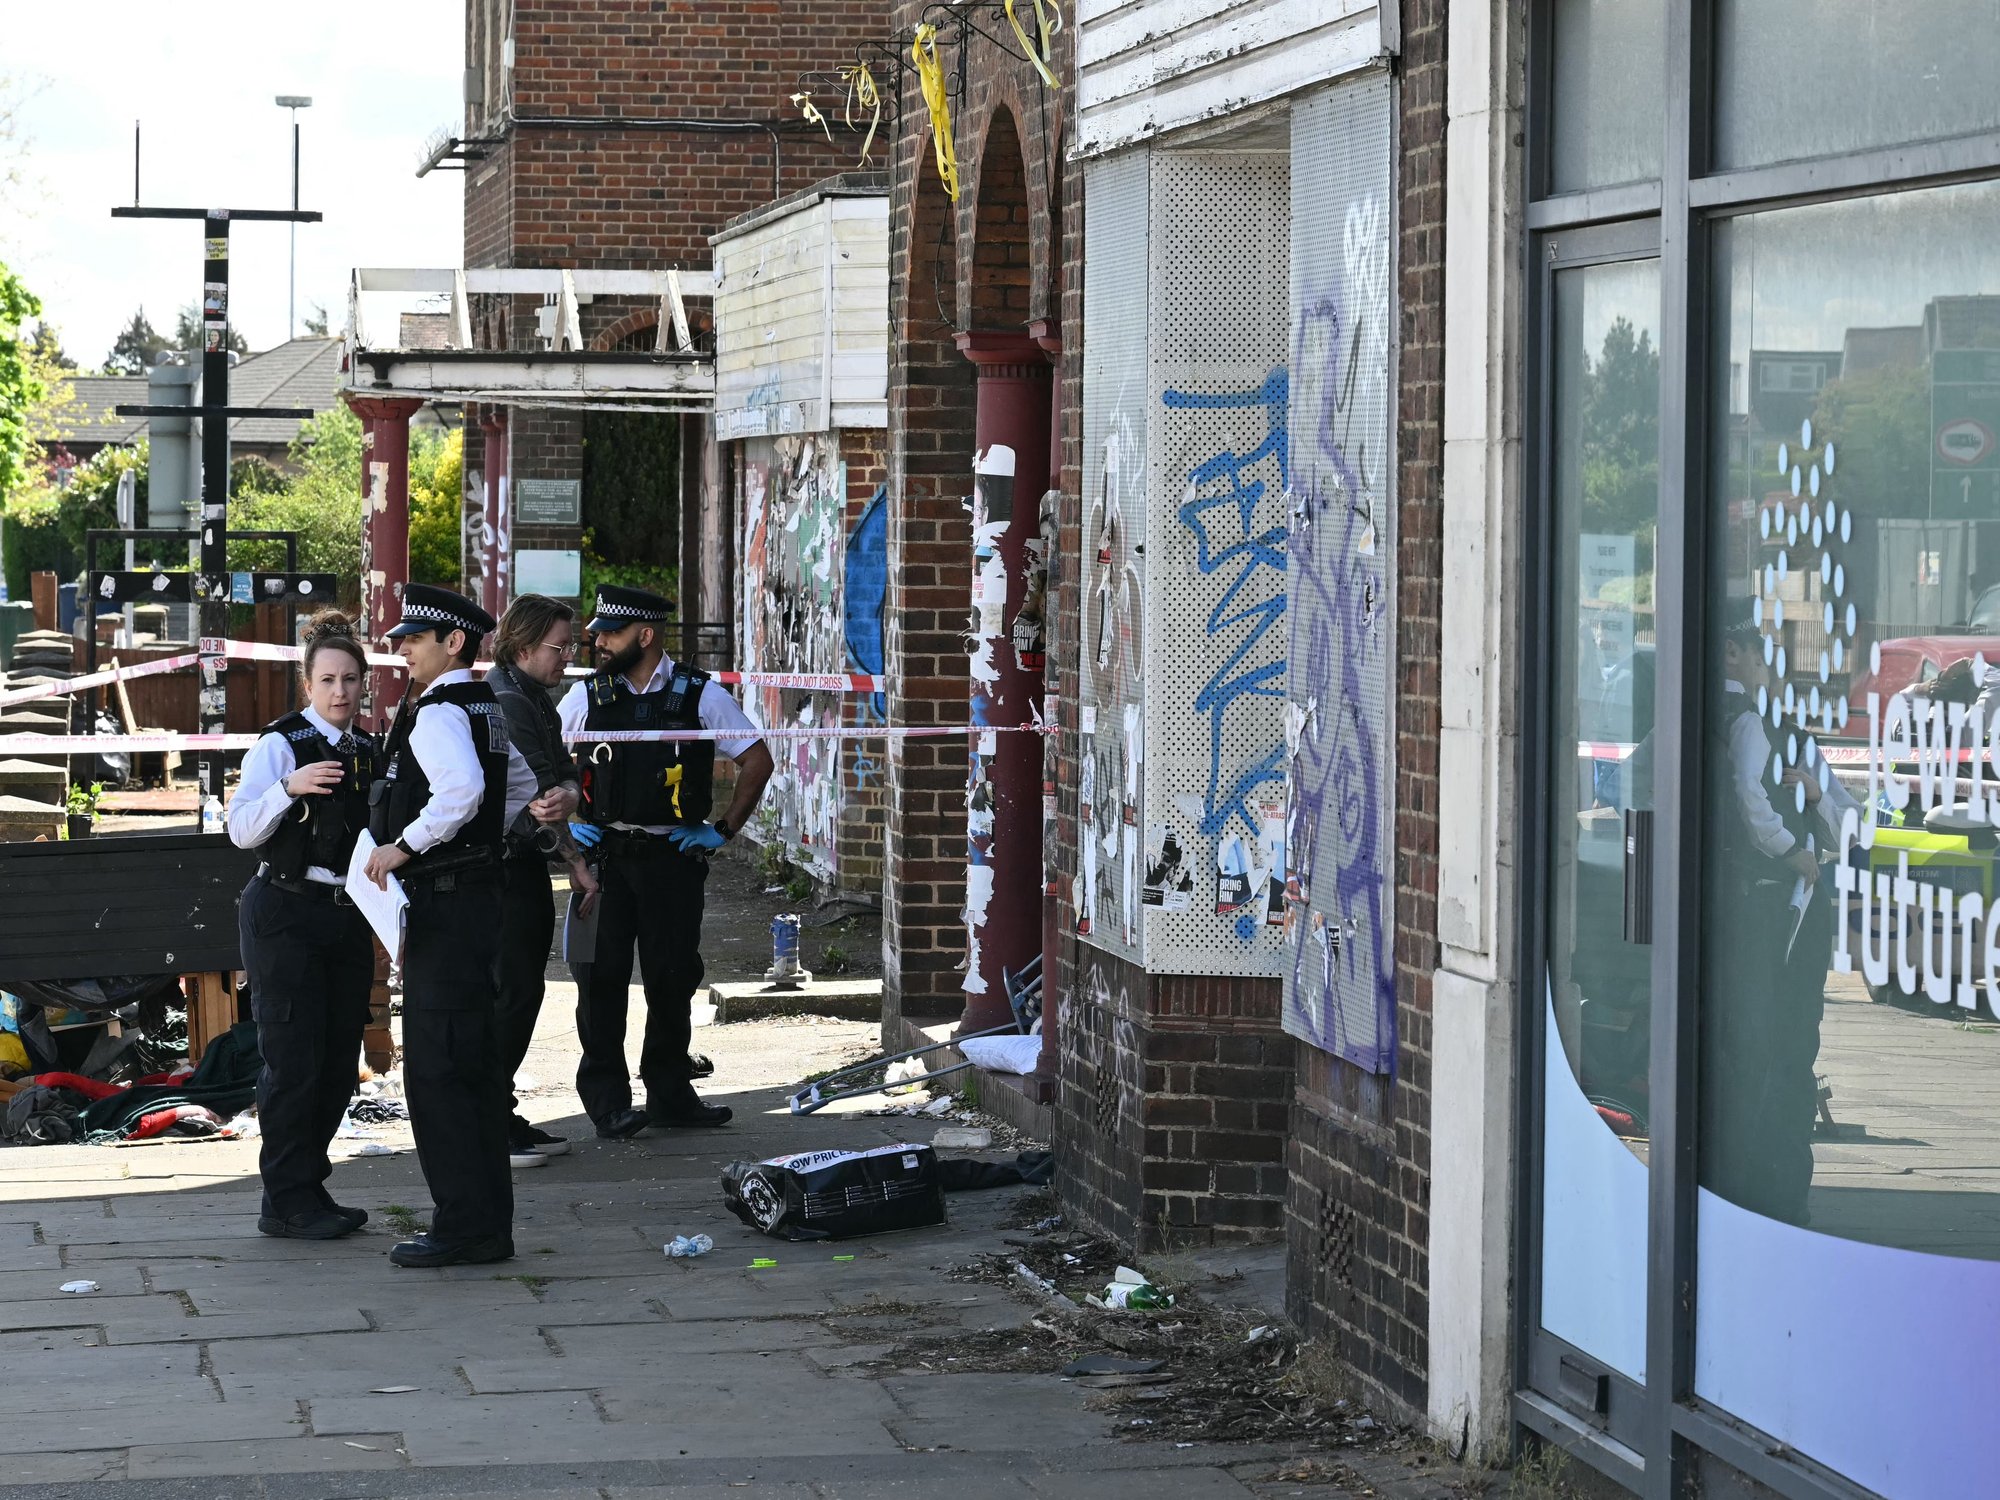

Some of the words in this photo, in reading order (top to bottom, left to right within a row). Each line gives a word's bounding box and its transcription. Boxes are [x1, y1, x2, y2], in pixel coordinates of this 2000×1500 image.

[1013, 624, 1038, 638] BRING
[749, 674, 773, 686] POLICE
[775, 675, 791, 687] LINE
[791, 676, 802, 687] DO
[803, 676, 818, 688] NOT
[819, 676, 843, 690] CROSS
[1219, 878, 1243, 892] BRING
[1219, 891, 1233, 902] HIM
[1834, 807, 2000, 1021] future
[788, 1156, 810, 1170] OW
